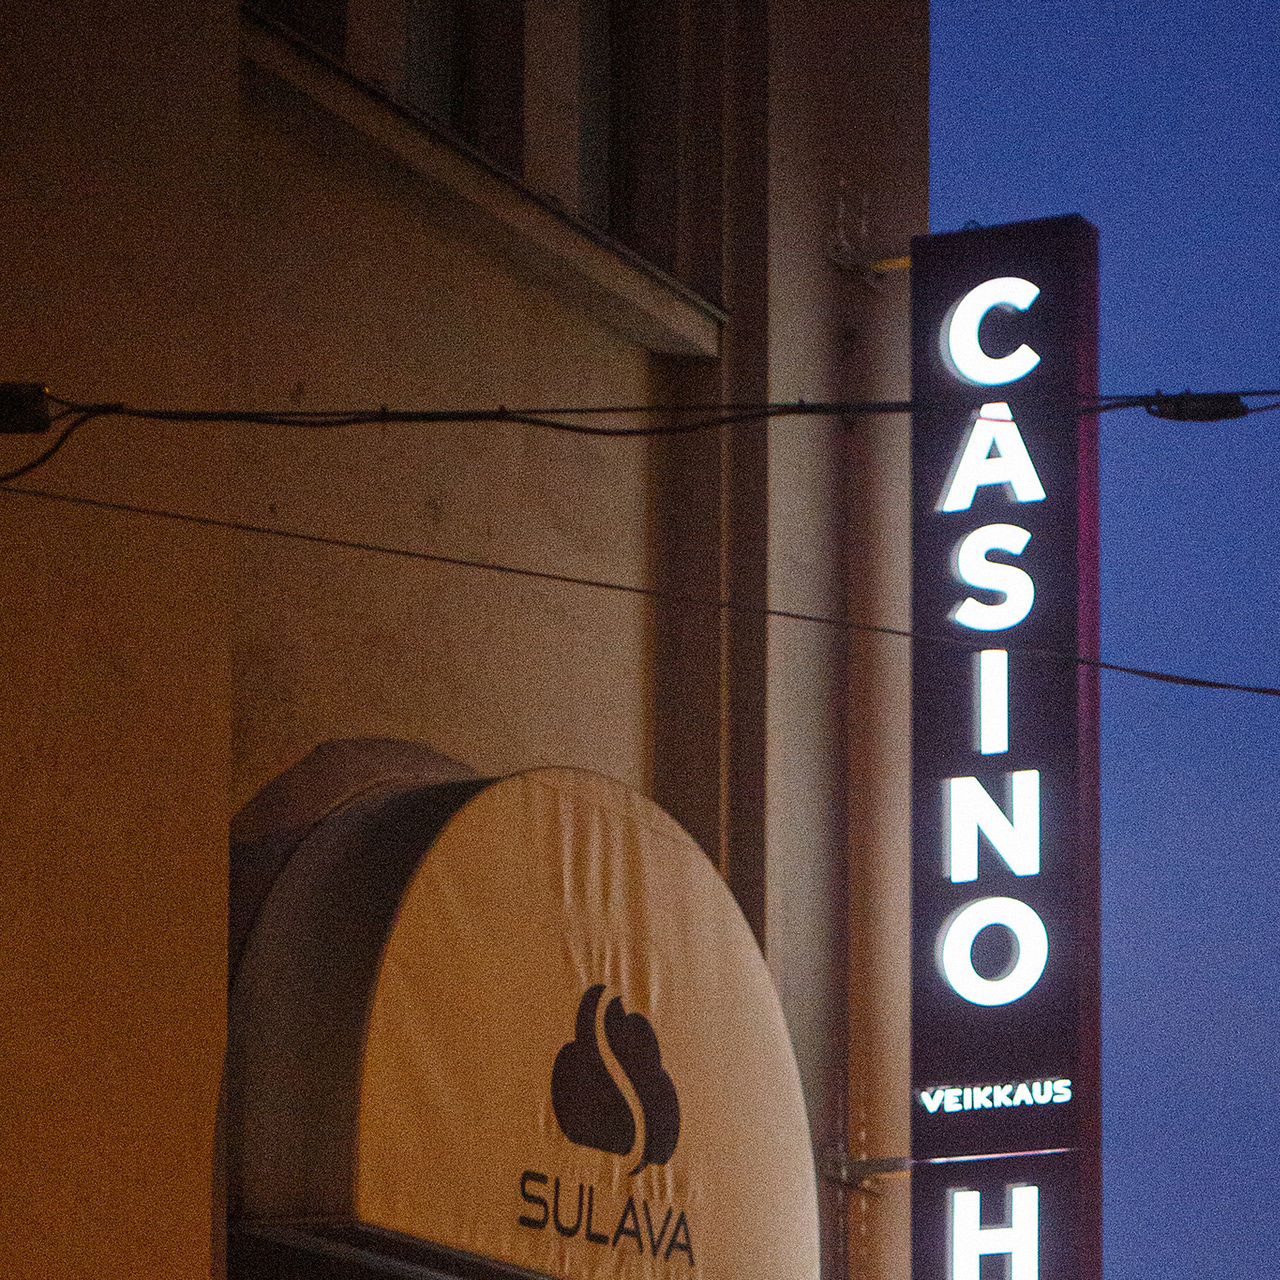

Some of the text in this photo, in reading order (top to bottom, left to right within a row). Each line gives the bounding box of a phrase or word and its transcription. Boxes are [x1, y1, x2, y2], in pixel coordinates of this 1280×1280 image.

[938, 277, 1049, 1007] CASINO
[920, 1079, 1072, 1114] VEIKKAUS
[517, 1170, 695, 1267] SULAVA
